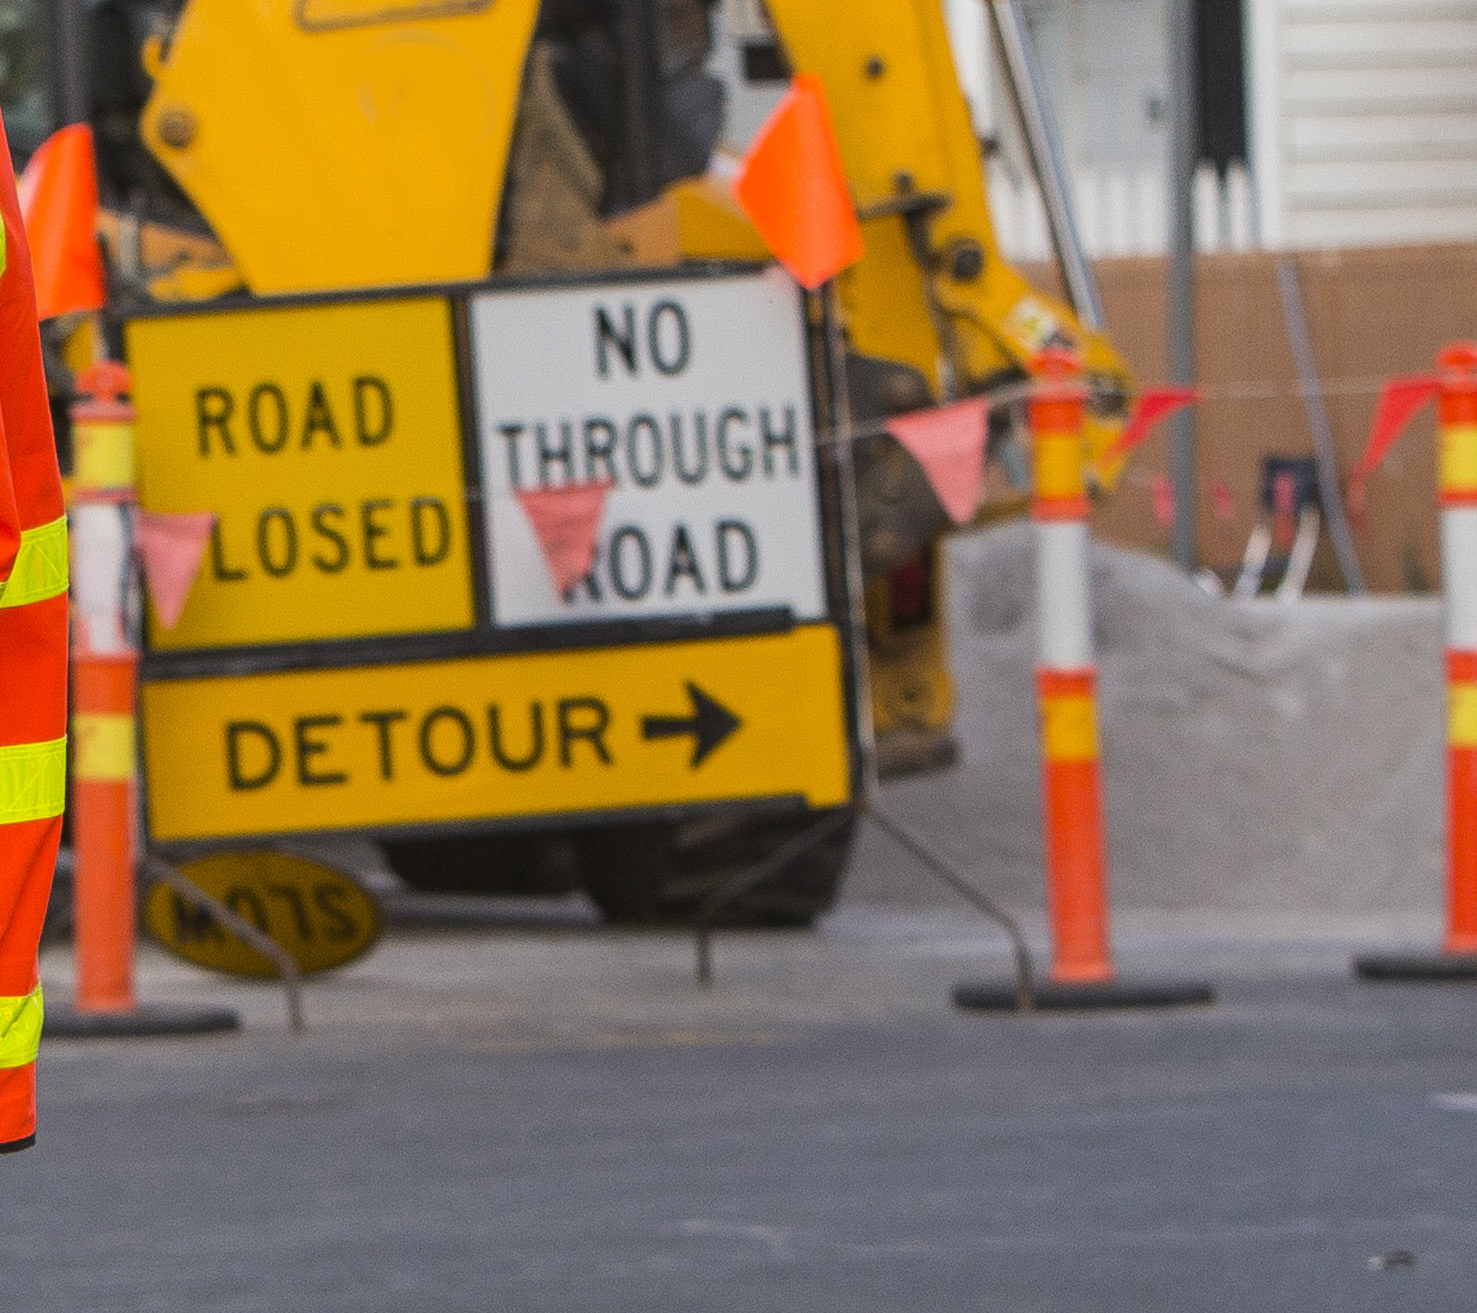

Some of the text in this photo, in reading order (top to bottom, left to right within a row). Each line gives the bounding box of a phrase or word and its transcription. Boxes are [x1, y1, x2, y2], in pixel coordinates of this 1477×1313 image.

[594, 297, 692, 380] NO
[195, 373, 394, 459] ROAD
[498, 401, 799, 488] THROUGH
[209, 495, 451, 581] LOSED
[225, 694, 614, 792] DETOUR
